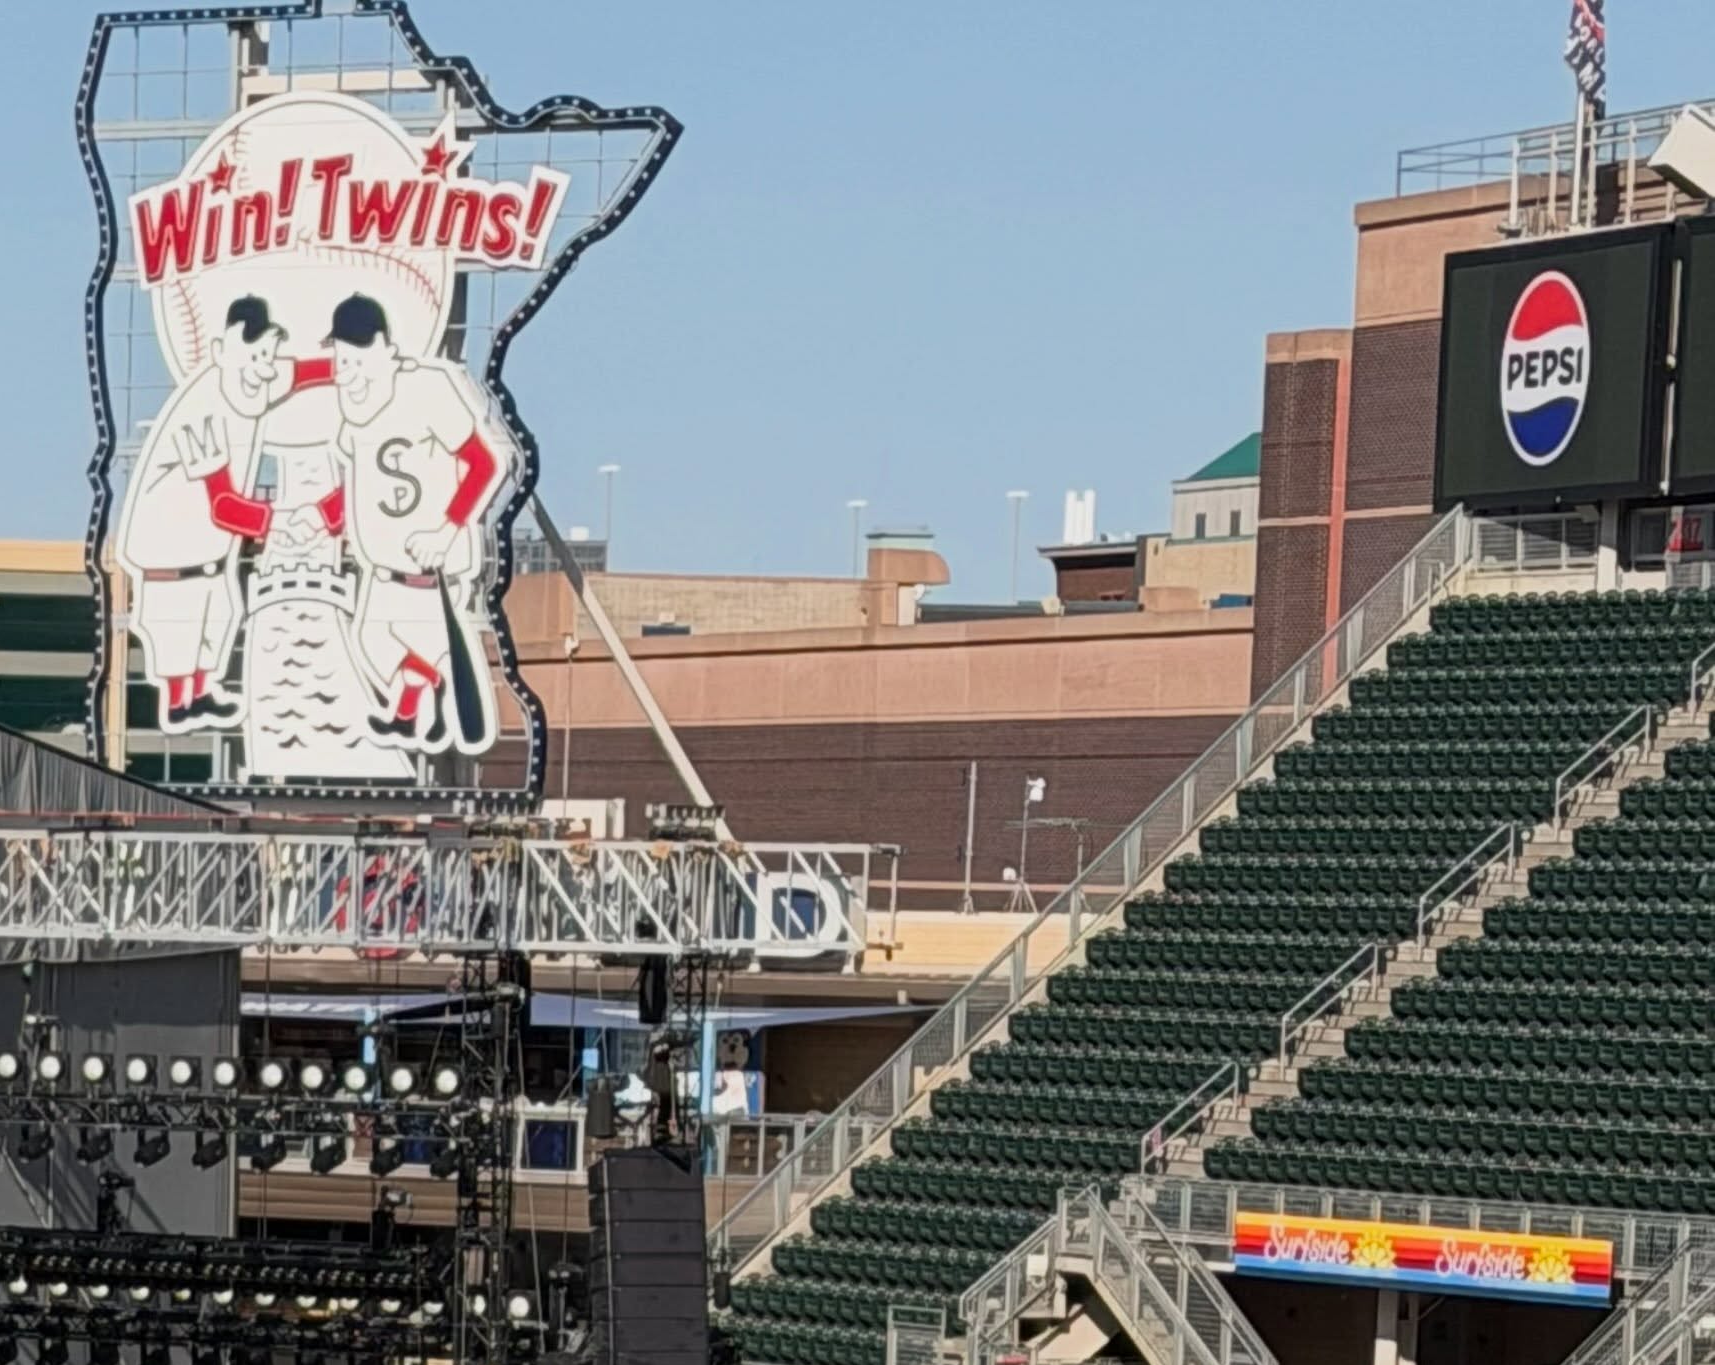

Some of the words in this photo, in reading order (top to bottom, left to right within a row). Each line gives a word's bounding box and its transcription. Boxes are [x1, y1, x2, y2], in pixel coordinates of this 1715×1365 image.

[135, 155, 304, 282] Win!
[311, 142, 558, 261] Twins!
[1507, 346, 1584, 391] PEPSI
[182, 415, 222, 466] M
[1264, 1224, 1351, 1264] Surfside
[1436, 1236, 1526, 1279] Surfside
